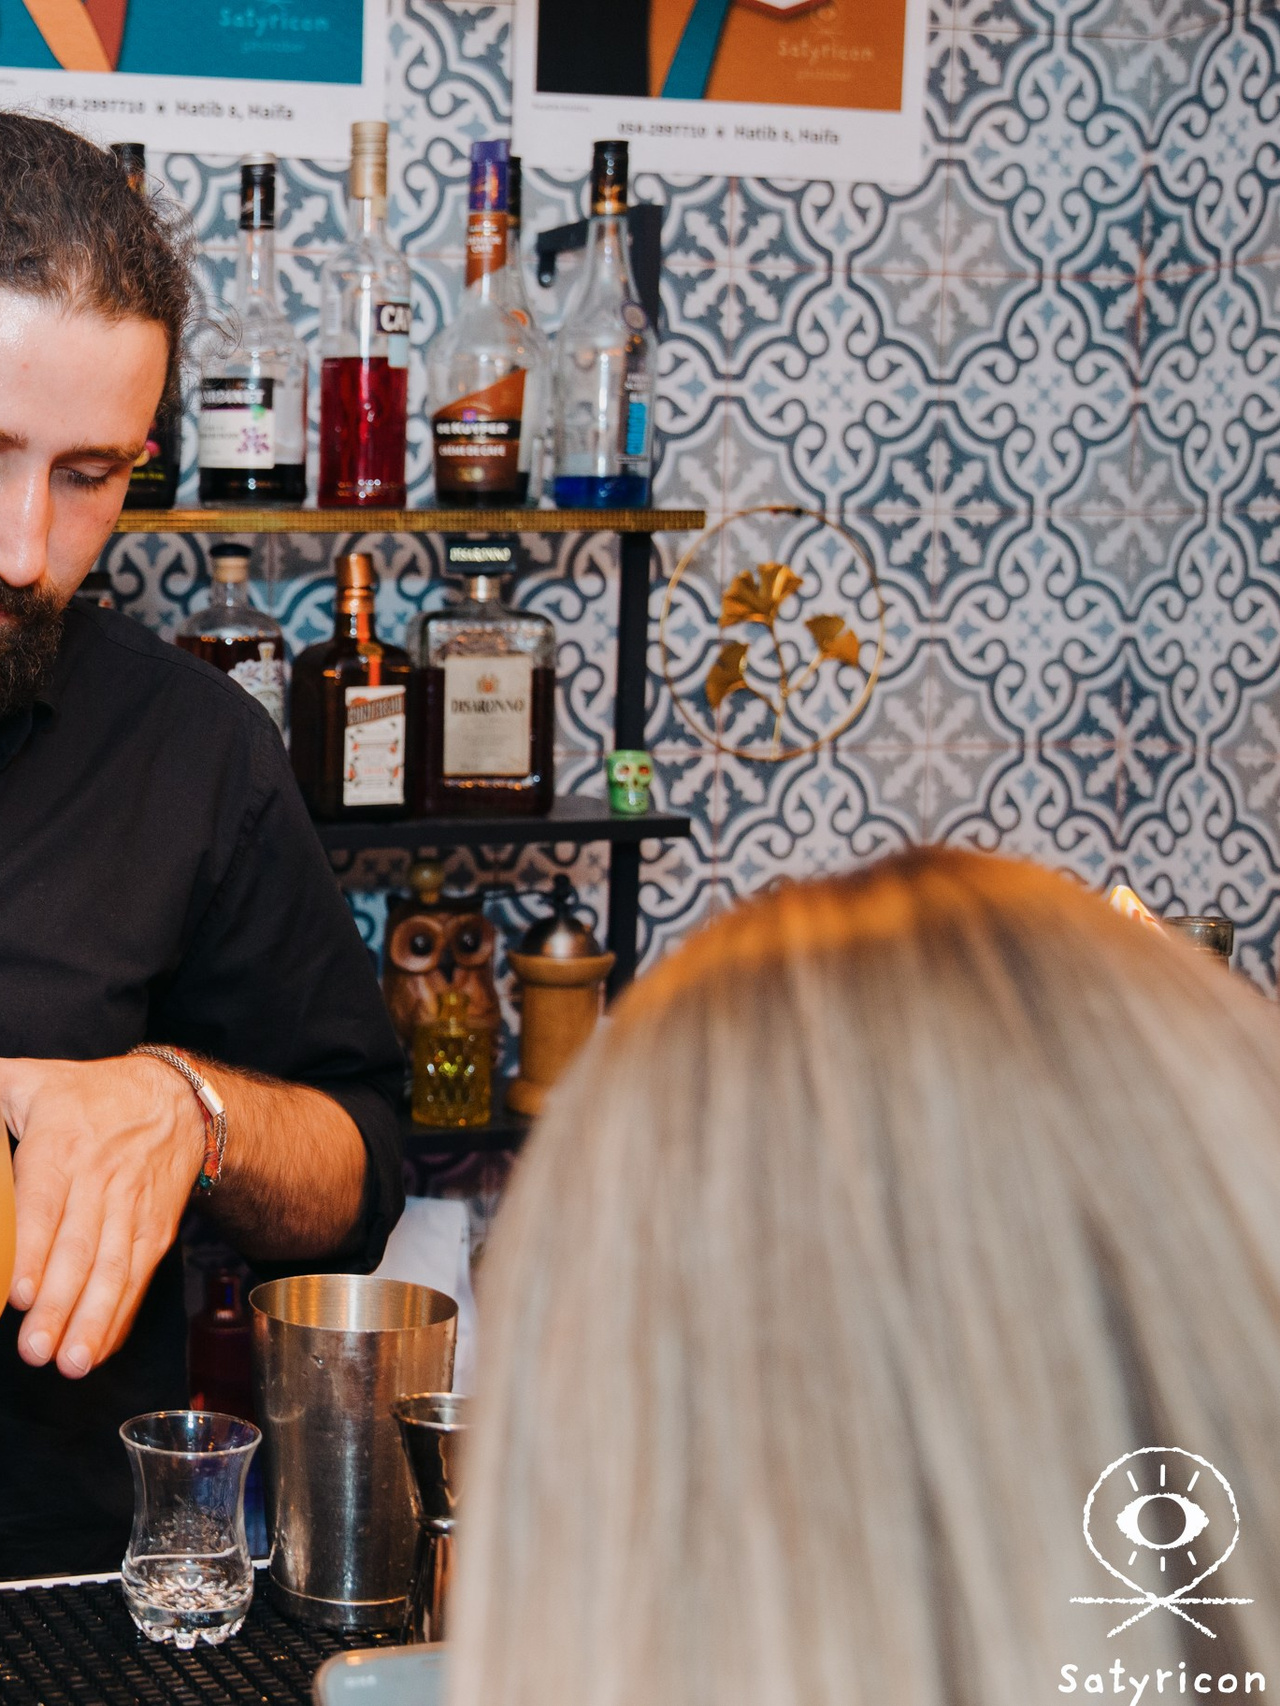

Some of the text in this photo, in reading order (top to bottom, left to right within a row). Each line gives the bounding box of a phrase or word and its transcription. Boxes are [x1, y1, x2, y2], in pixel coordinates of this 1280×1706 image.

[176, 102, 224, 118] Hatib
[248, 103, 294, 120] Haifa
[734, 124, 777, 142] Hatib
[799, 127, 840, 145] Haifa
[449, 546, 512, 562] DISARONNO
[451, 698, 525, 714] DISARONNO
